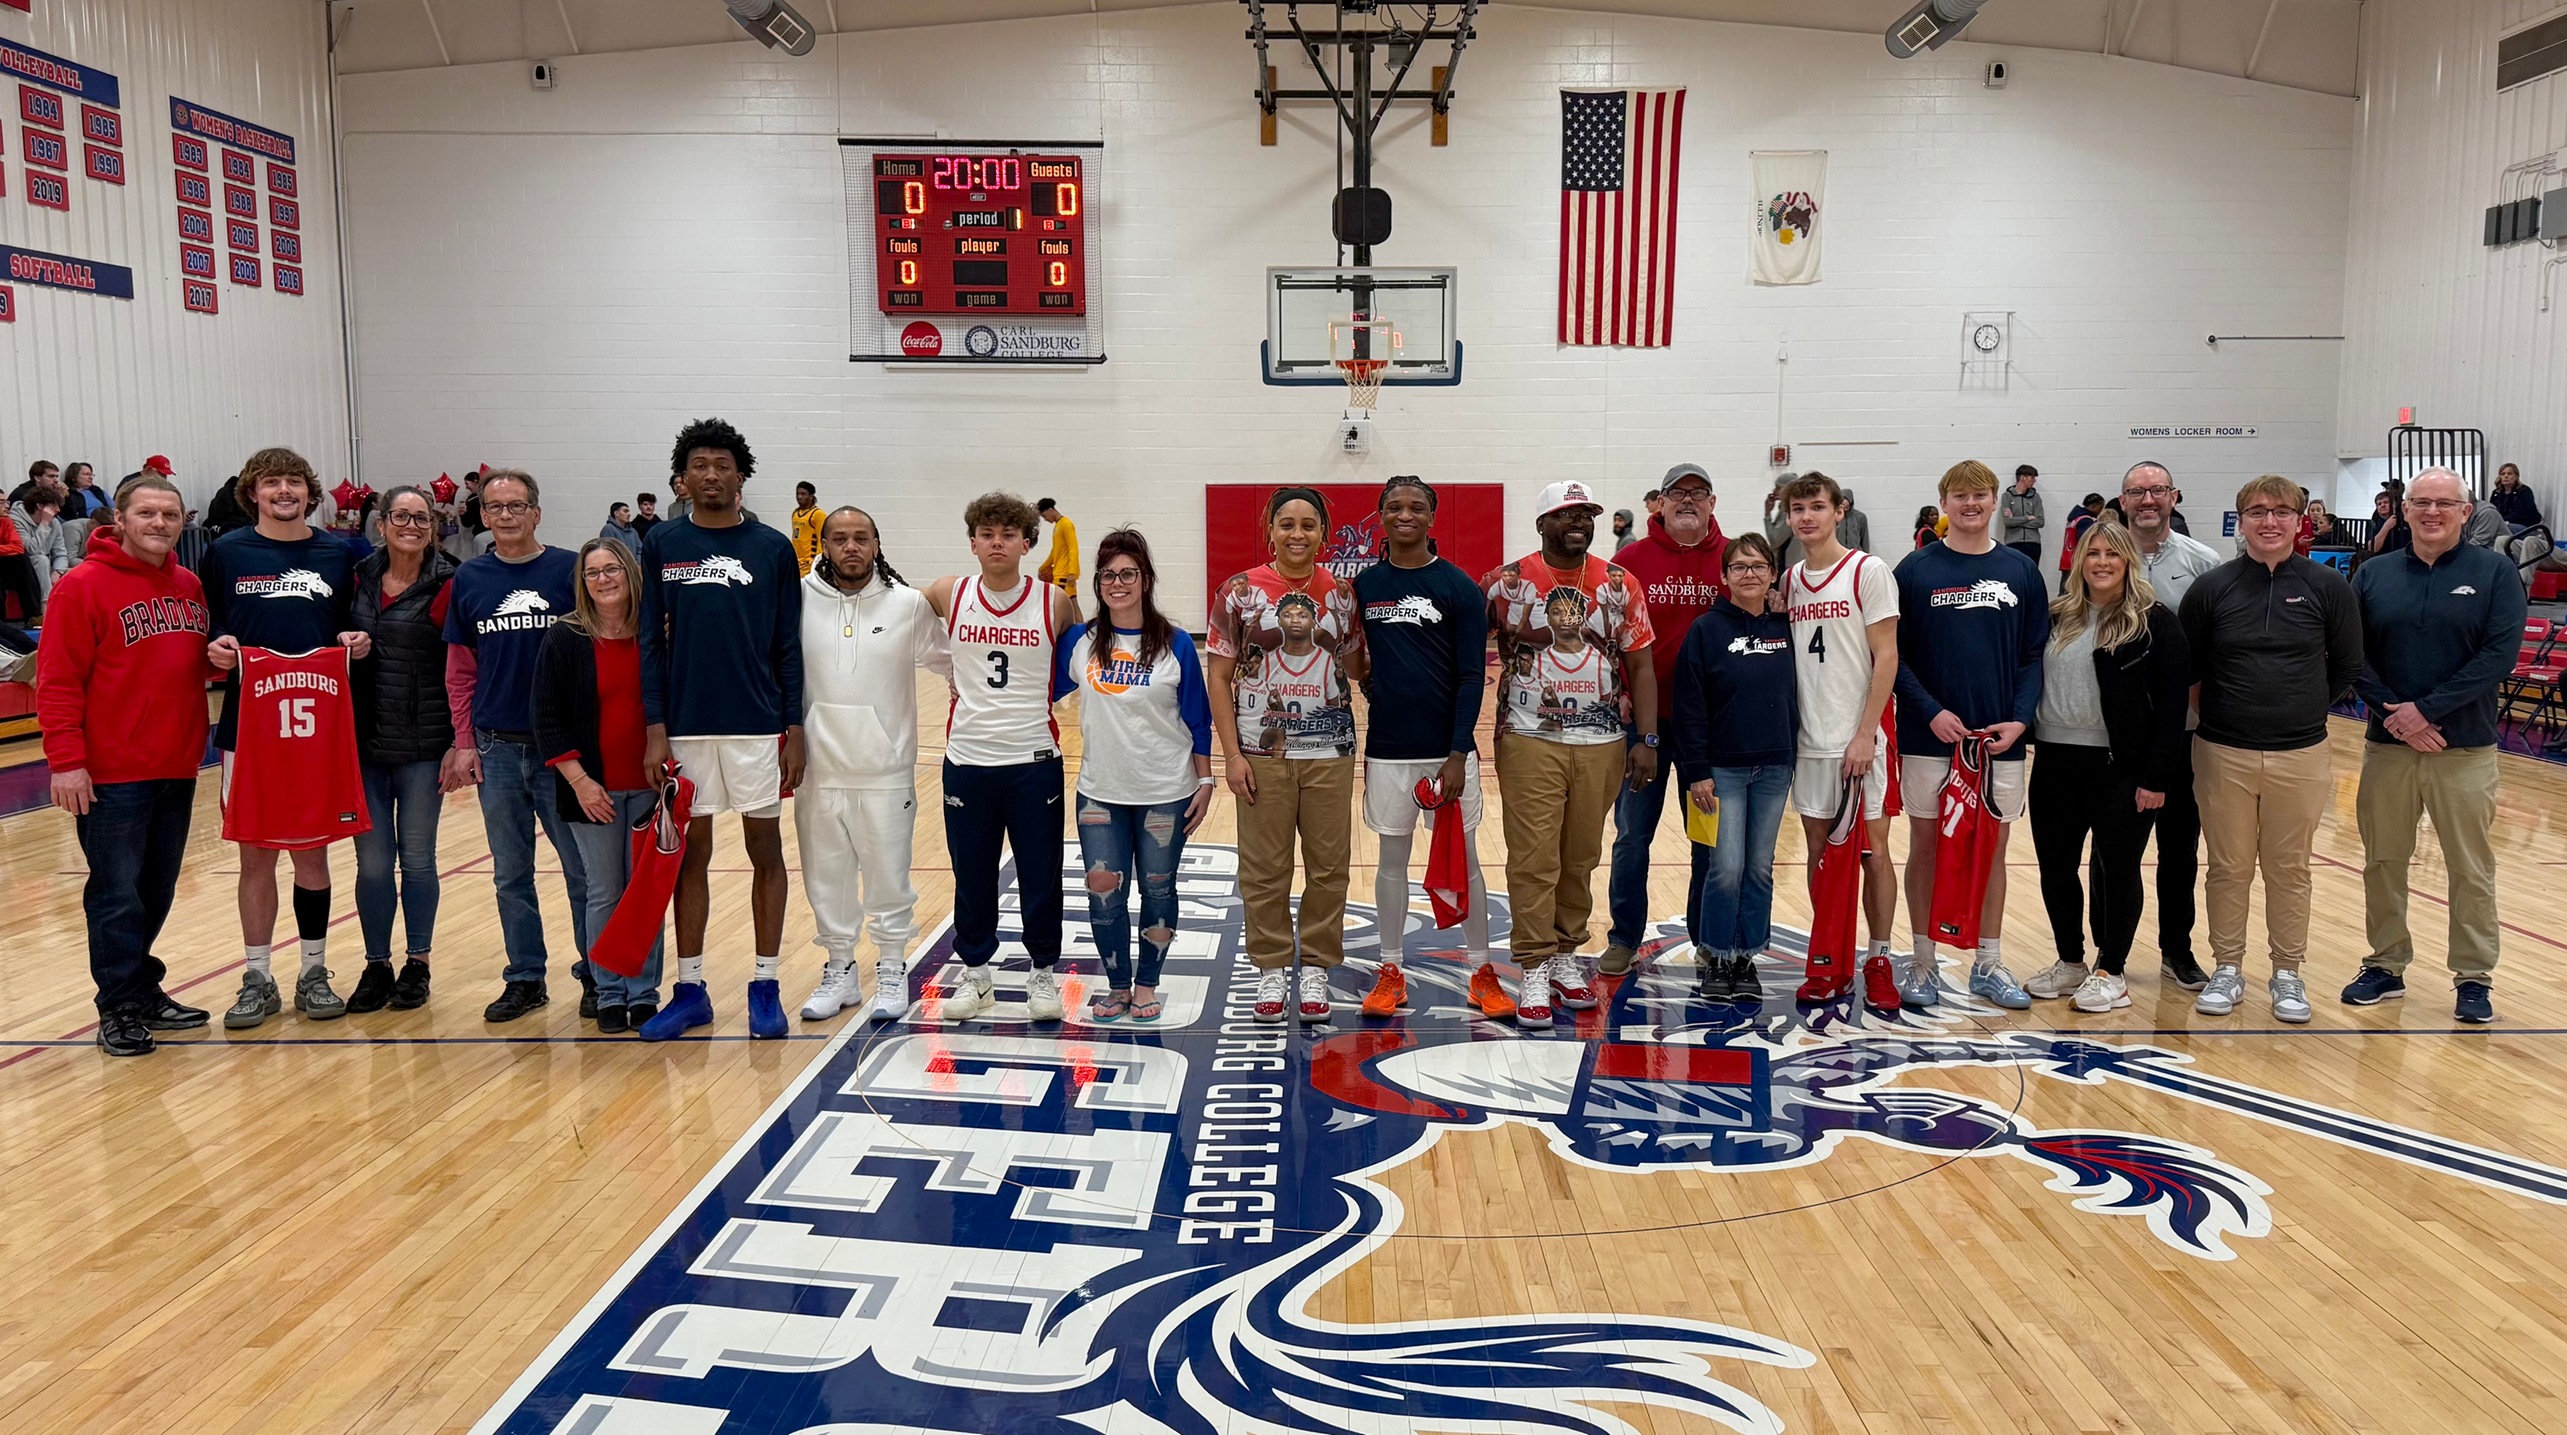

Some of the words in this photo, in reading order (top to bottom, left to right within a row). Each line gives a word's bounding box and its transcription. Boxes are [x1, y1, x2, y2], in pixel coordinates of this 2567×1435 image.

[28, 93, 58, 122] 1984
[88, 113, 116, 140] 1985
[190, 109, 234, 142] WOMEN'S
[235, 124, 292, 160] BASKETBALL
[30, 135, 60, 162] 1987
[179, 141, 203, 165] 1983
[92, 151, 120, 177] 1990
[228, 156, 250, 179] 1984
[883, 160, 916, 175] Home
[934, 157, 1020, 190] 20:00
[1031, 162, 1073, 177] Guests
[33, 177, 63, 204] 2019
[182, 178, 205, 200] 1986
[272, 170, 293, 191] 1985
[904, 181, 925, 214] 0
[1056, 183, 1077, 216] 0
[275, 202, 295, 223] 1997
[959, 211, 998, 227] period
[184, 214, 208, 238] 2004
[232, 225, 254, 247] 2005
[890, 239, 918, 253] fouls
[961, 238, 1000, 254] player
[1041, 240, 1069, 254] fouls
[10, 253, 95, 289] SOFTBALL
[186, 250, 210, 272] 2007
[901, 260, 916, 284] 0
[278, 268, 299, 290] 2016
[1051, 262, 1066, 286] 0
[189, 286, 213, 308] 2017
[894, 293, 917, 304] won
[966, 294, 996, 308] game
[1045, 295, 1068, 305] won
[1001, 326, 1036, 335] CARL
[1001, 336, 1080, 351] SANDBURG
[2130, 428, 2170, 436] WOMENS
[662, 567, 727, 581] CHARGERS
[236, 581, 308, 594] CHARGERS
[1648, 584, 1719, 598] SANDBURG
[1931, 592, 1996, 606] CHARGERS
[477, 615, 558, 634] SANDBUR
[1365, 607, 1419, 620] CHARGERS
[959, 624, 1040, 647] CHARGERS
[1808, 625, 1825, 663] 4
[987, 650, 1009, 688] 3
[1100, 671, 1150, 687] MAMA
[254, 671, 339, 698] SANDBURG
[279, 699, 316, 738] 15
[1177, 1083, 1284, 1245] COLLEGE
